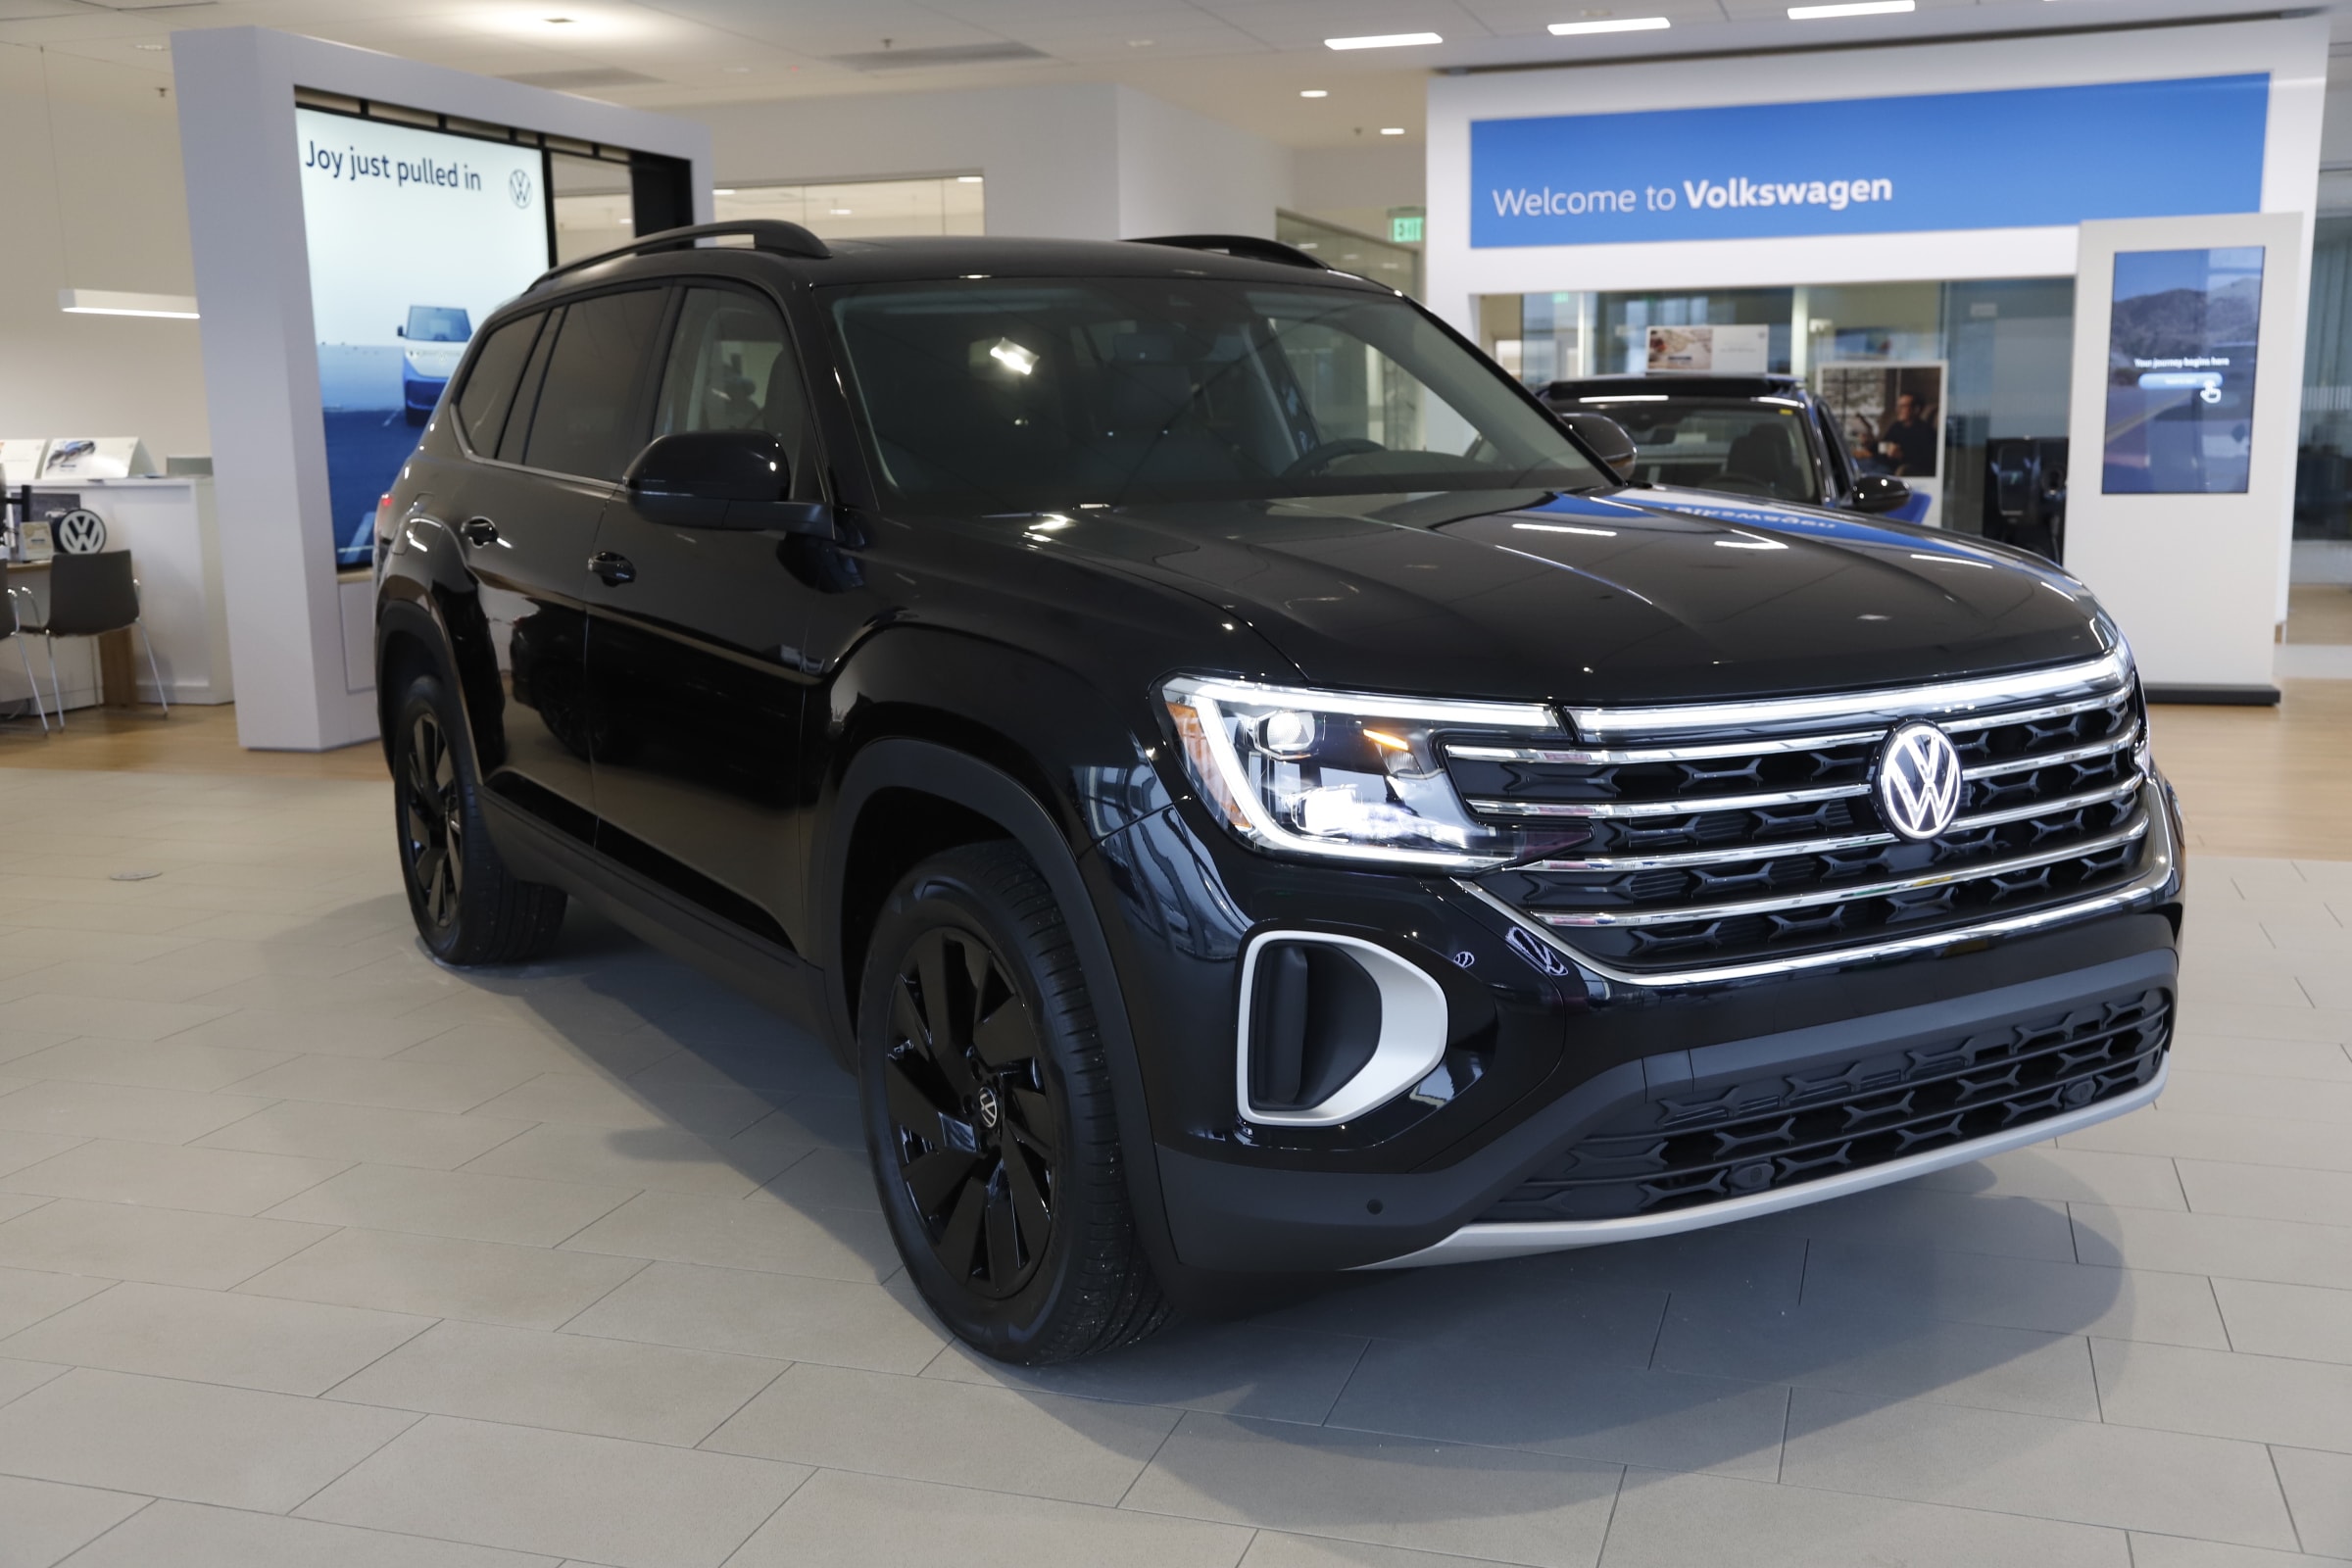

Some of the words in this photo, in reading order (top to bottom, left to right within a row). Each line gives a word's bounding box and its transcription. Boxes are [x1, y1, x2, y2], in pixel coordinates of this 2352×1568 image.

[306, 140, 343, 178] Joy
[350, 146, 390, 180] just
[397, 158, 458, 187] pulled
[464, 165, 481, 190] in
[1493, 186, 1637, 218] Welcome
[1646, 185, 1676, 212] to
[1684, 177, 1892, 211] Volkswagen
[2134, 358, 2152, 368] Your
[2152, 358, 2182, 368] journey
[2183, 357, 2211, 368] begins
[2211, 357, 2230, 366] here
[1880, 724, 1961, 840] VW
